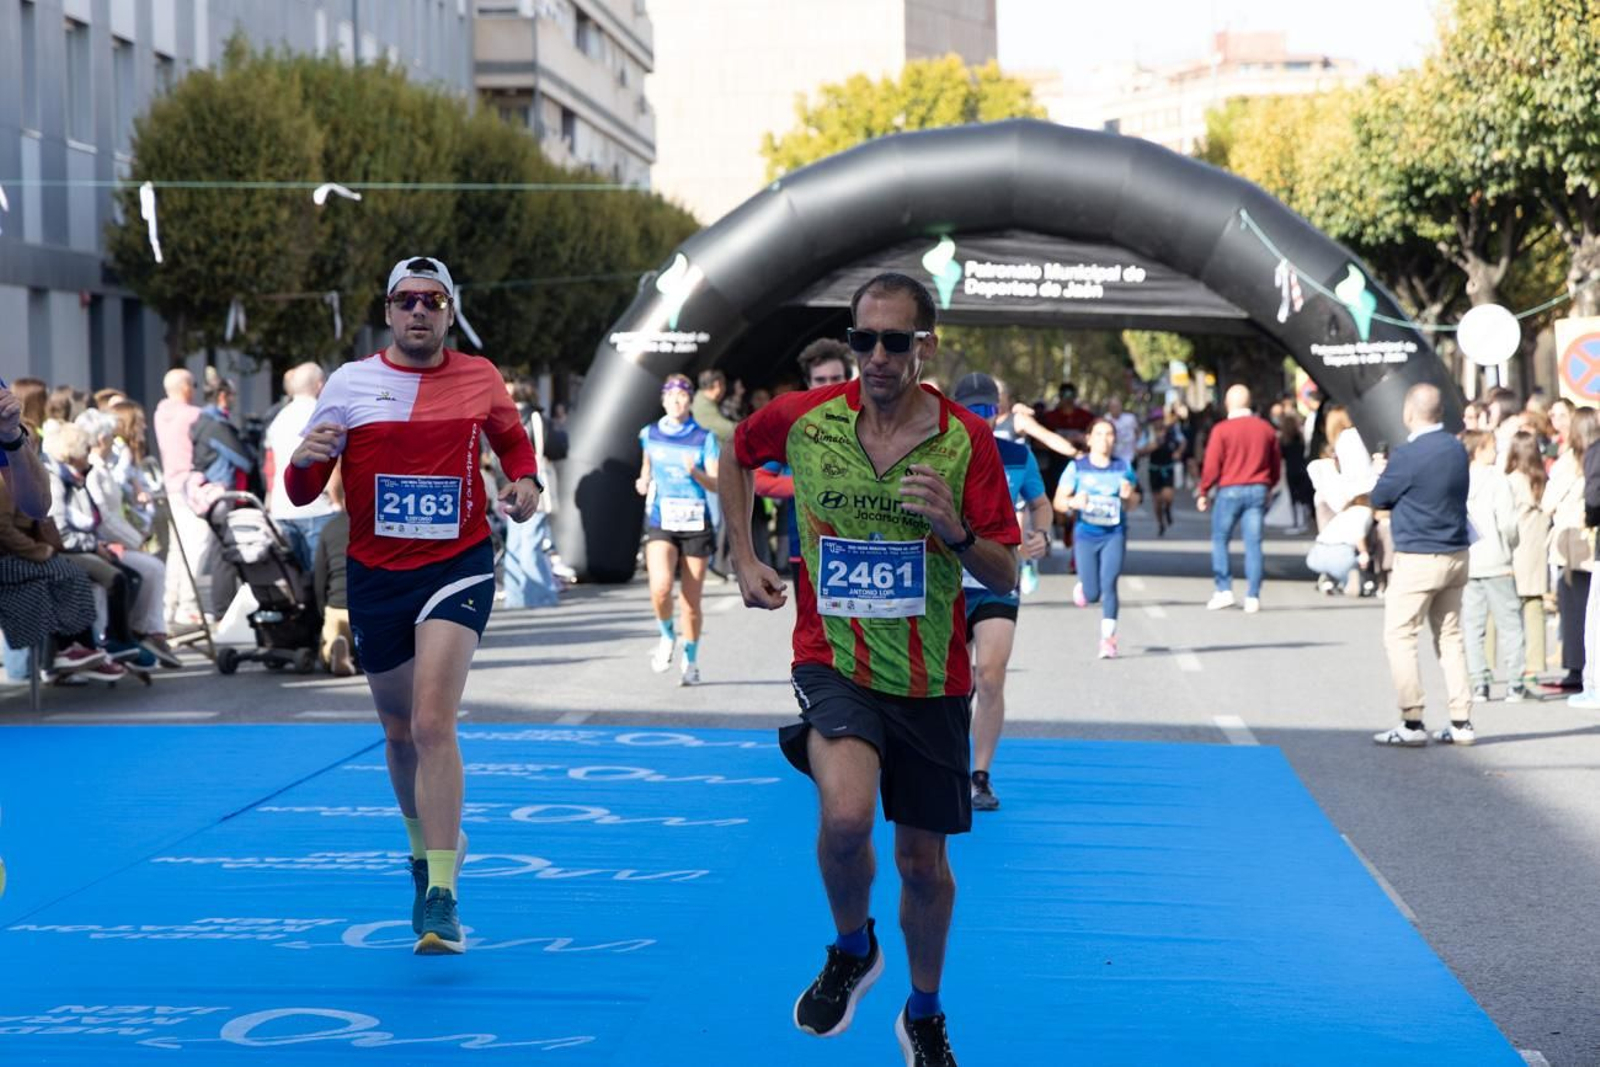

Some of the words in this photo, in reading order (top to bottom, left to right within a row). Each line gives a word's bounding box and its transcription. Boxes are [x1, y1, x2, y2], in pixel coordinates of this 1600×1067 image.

[964, 260, 1043, 281] Patronato
[1044, 262, 1122, 284] Municipal
[1122, 265, 1147, 283] de
[964, 278, 1038, 300] Deportes
[1038, 280, 1063, 298] de
[383, 492, 453, 516] 2163
[853, 494, 923, 519] HYUN
[827, 560, 912, 589] 2461
